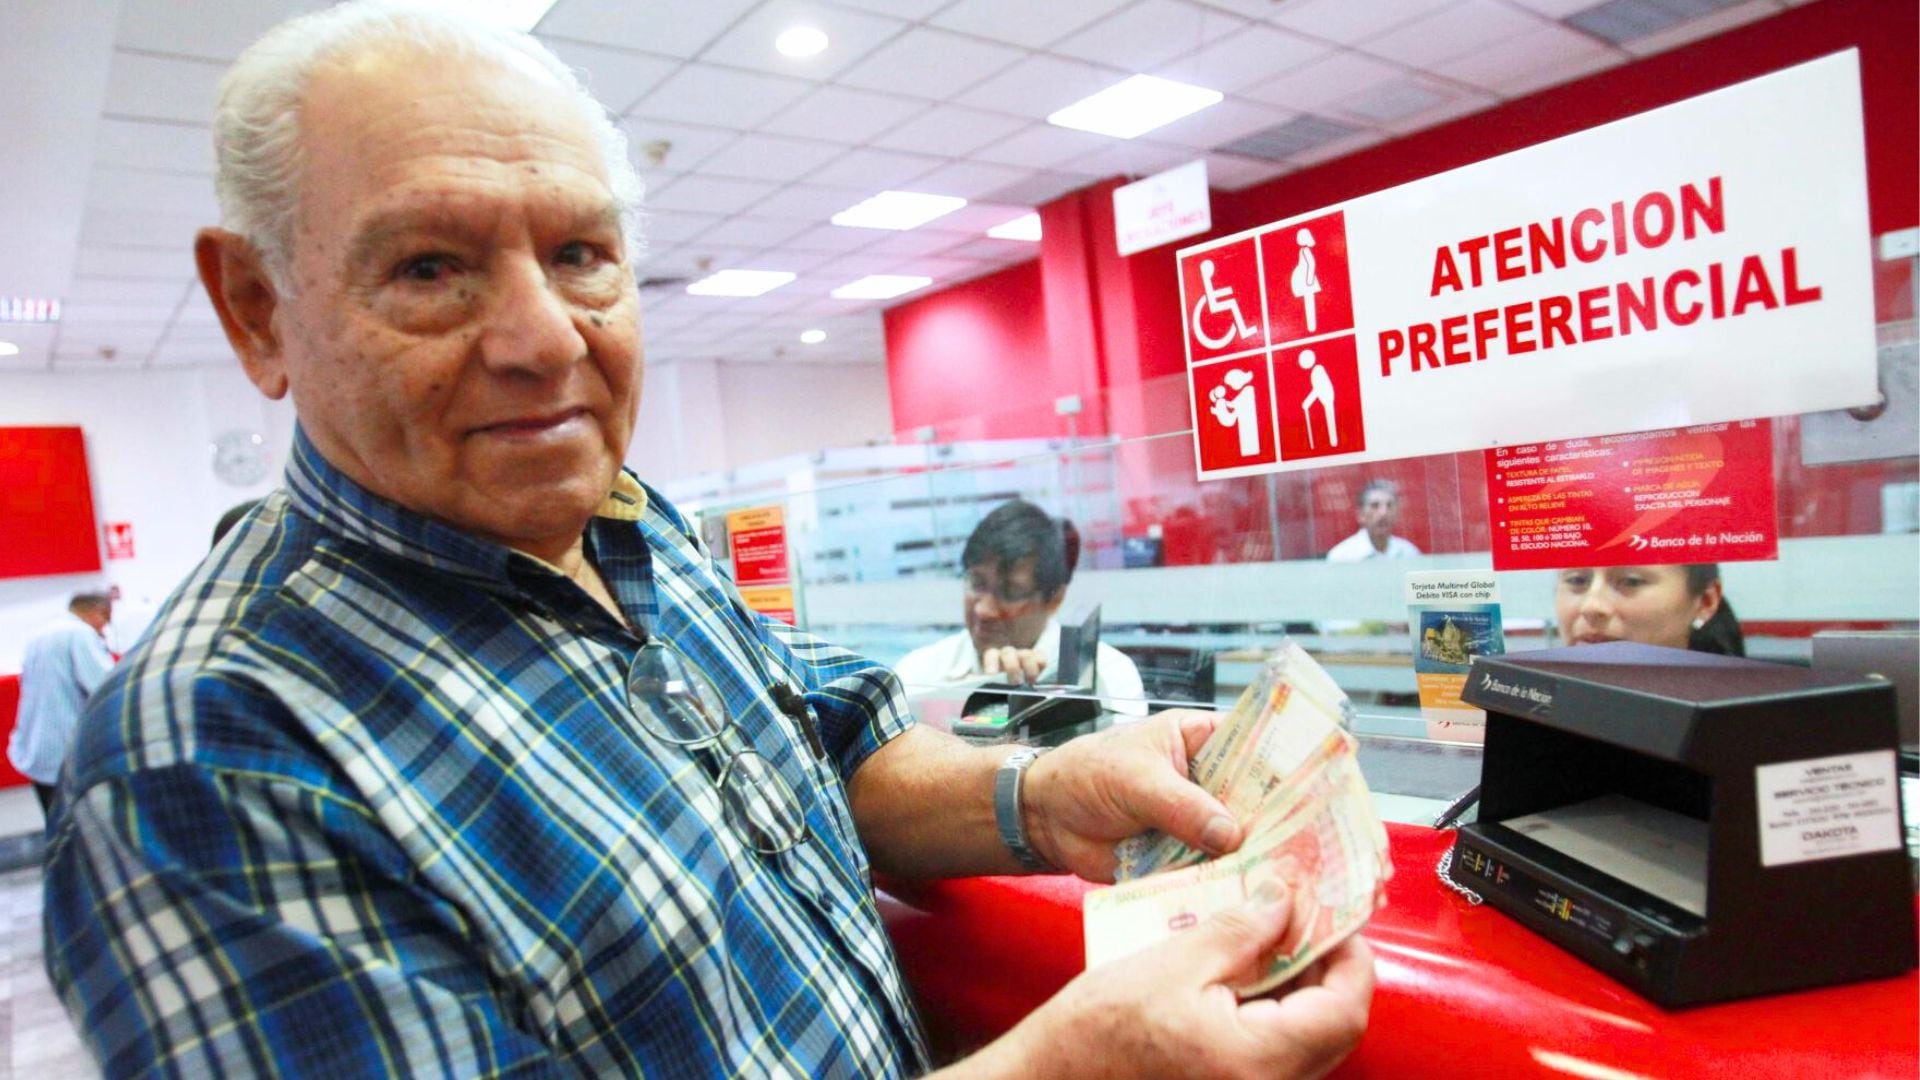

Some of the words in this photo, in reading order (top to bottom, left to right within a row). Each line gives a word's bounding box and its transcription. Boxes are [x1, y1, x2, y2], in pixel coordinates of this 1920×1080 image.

[1430, 176, 1726, 298] ATENCION
[1378, 247, 1823, 377] PREFERENCIAL
[1496, 447, 1508, 457] En
[1516, 445, 1537, 455] caso
[1545, 441, 1557, 451] de
[1601, 431, 1677, 444] recomendamos
[1497, 456, 1541, 469] siguientes
[1505, 469, 1539, 479] TEXTURA
[1540, 467, 1549, 476] DE
[1506, 476, 1545, 487] RESISTENTE
[1547, 475, 1556, 484] AL
[1541, 493, 1552, 501] DE
[1553, 491, 1566, 500] LAS
[1634, 501, 1665, 511] EXACTA
[1667, 499, 1684, 508] DEL
[1684, 496, 1731, 507] PERSONAJE
[1510, 518, 1533, 527] TINTAS
[1534, 517, 1549, 526] QUE
[1551, 515, 1585, 524] CAMBIAN
[1510, 527, 1520, 535] DE
[1563, 531, 1581, 540] BAJO
[1650, 536, 1685, 548] Banco
[1688, 534, 1703, 546] de
[1705, 533, 1717, 545] la
[1720, 531, 1764, 544] Nación
[1511, 543, 1519, 551] EL
[1520, 541, 1549, 550] ESCUDO
[1411, 582, 1436, 591] Tarjeta
[1437, 581, 1469, 590] Multired
[1470, 580, 1496, 589] Global
[1441, 591, 1458, 599] VISA
[1475, 591, 1491, 600] chip
[1805, 764, 1853, 775] VENTAS
[1802, 826, 1858, 841] DAKOTA
